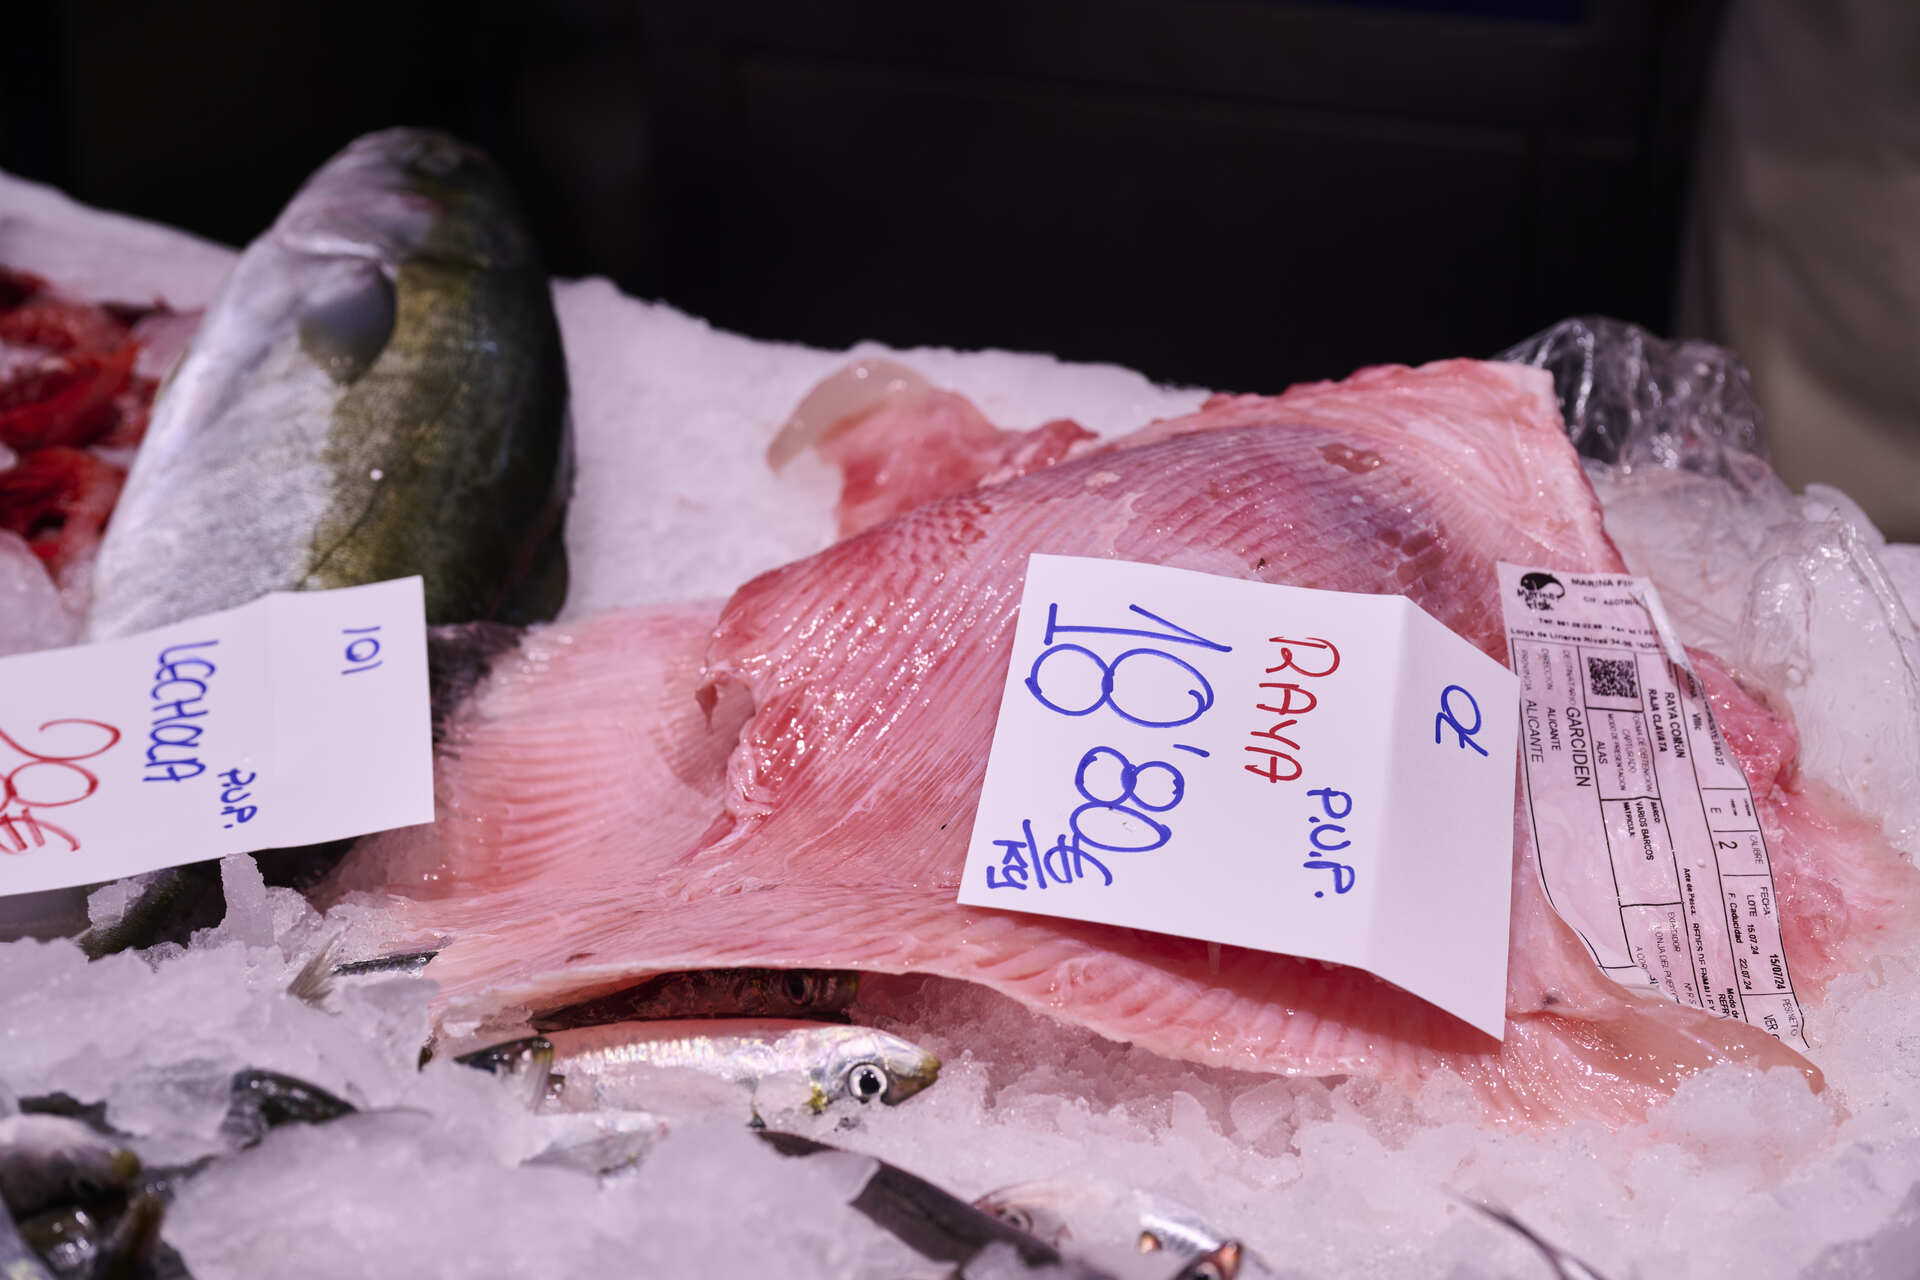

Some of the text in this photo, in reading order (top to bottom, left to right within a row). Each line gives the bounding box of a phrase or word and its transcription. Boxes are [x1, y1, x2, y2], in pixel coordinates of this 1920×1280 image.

[1243, 635, 1341, 786] RAYA
[1647, 689, 1668, 753] RAJA CLAVATA
[1664, 691, 1678, 722] RAYA
[1526, 699, 1544, 764] ALICANTE
[1547, 707, 1561, 752] ALICANTE
[1565, 706, 1592, 787] GARCIDEN
[1596, 740, 1609, 765] ALAS
[1710, 806, 1723, 816] E
[1635, 800, 1655, 861] VARIOS BARCOS
[1718, 840, 1739, 850] 2
[1749, 835, 1764, 866] CALIBRE
[1746, 894, 1758, 918] LOTE
[1728, 902, 1744, 945] Caducidad
[1738, 957, 1753, 991] 22.07.24
[1768, 953, 1787, 992] 15/07/24
[1725, 988, 1739, 1009] Modo
[1763, 1014, 1780, 1032] VER
